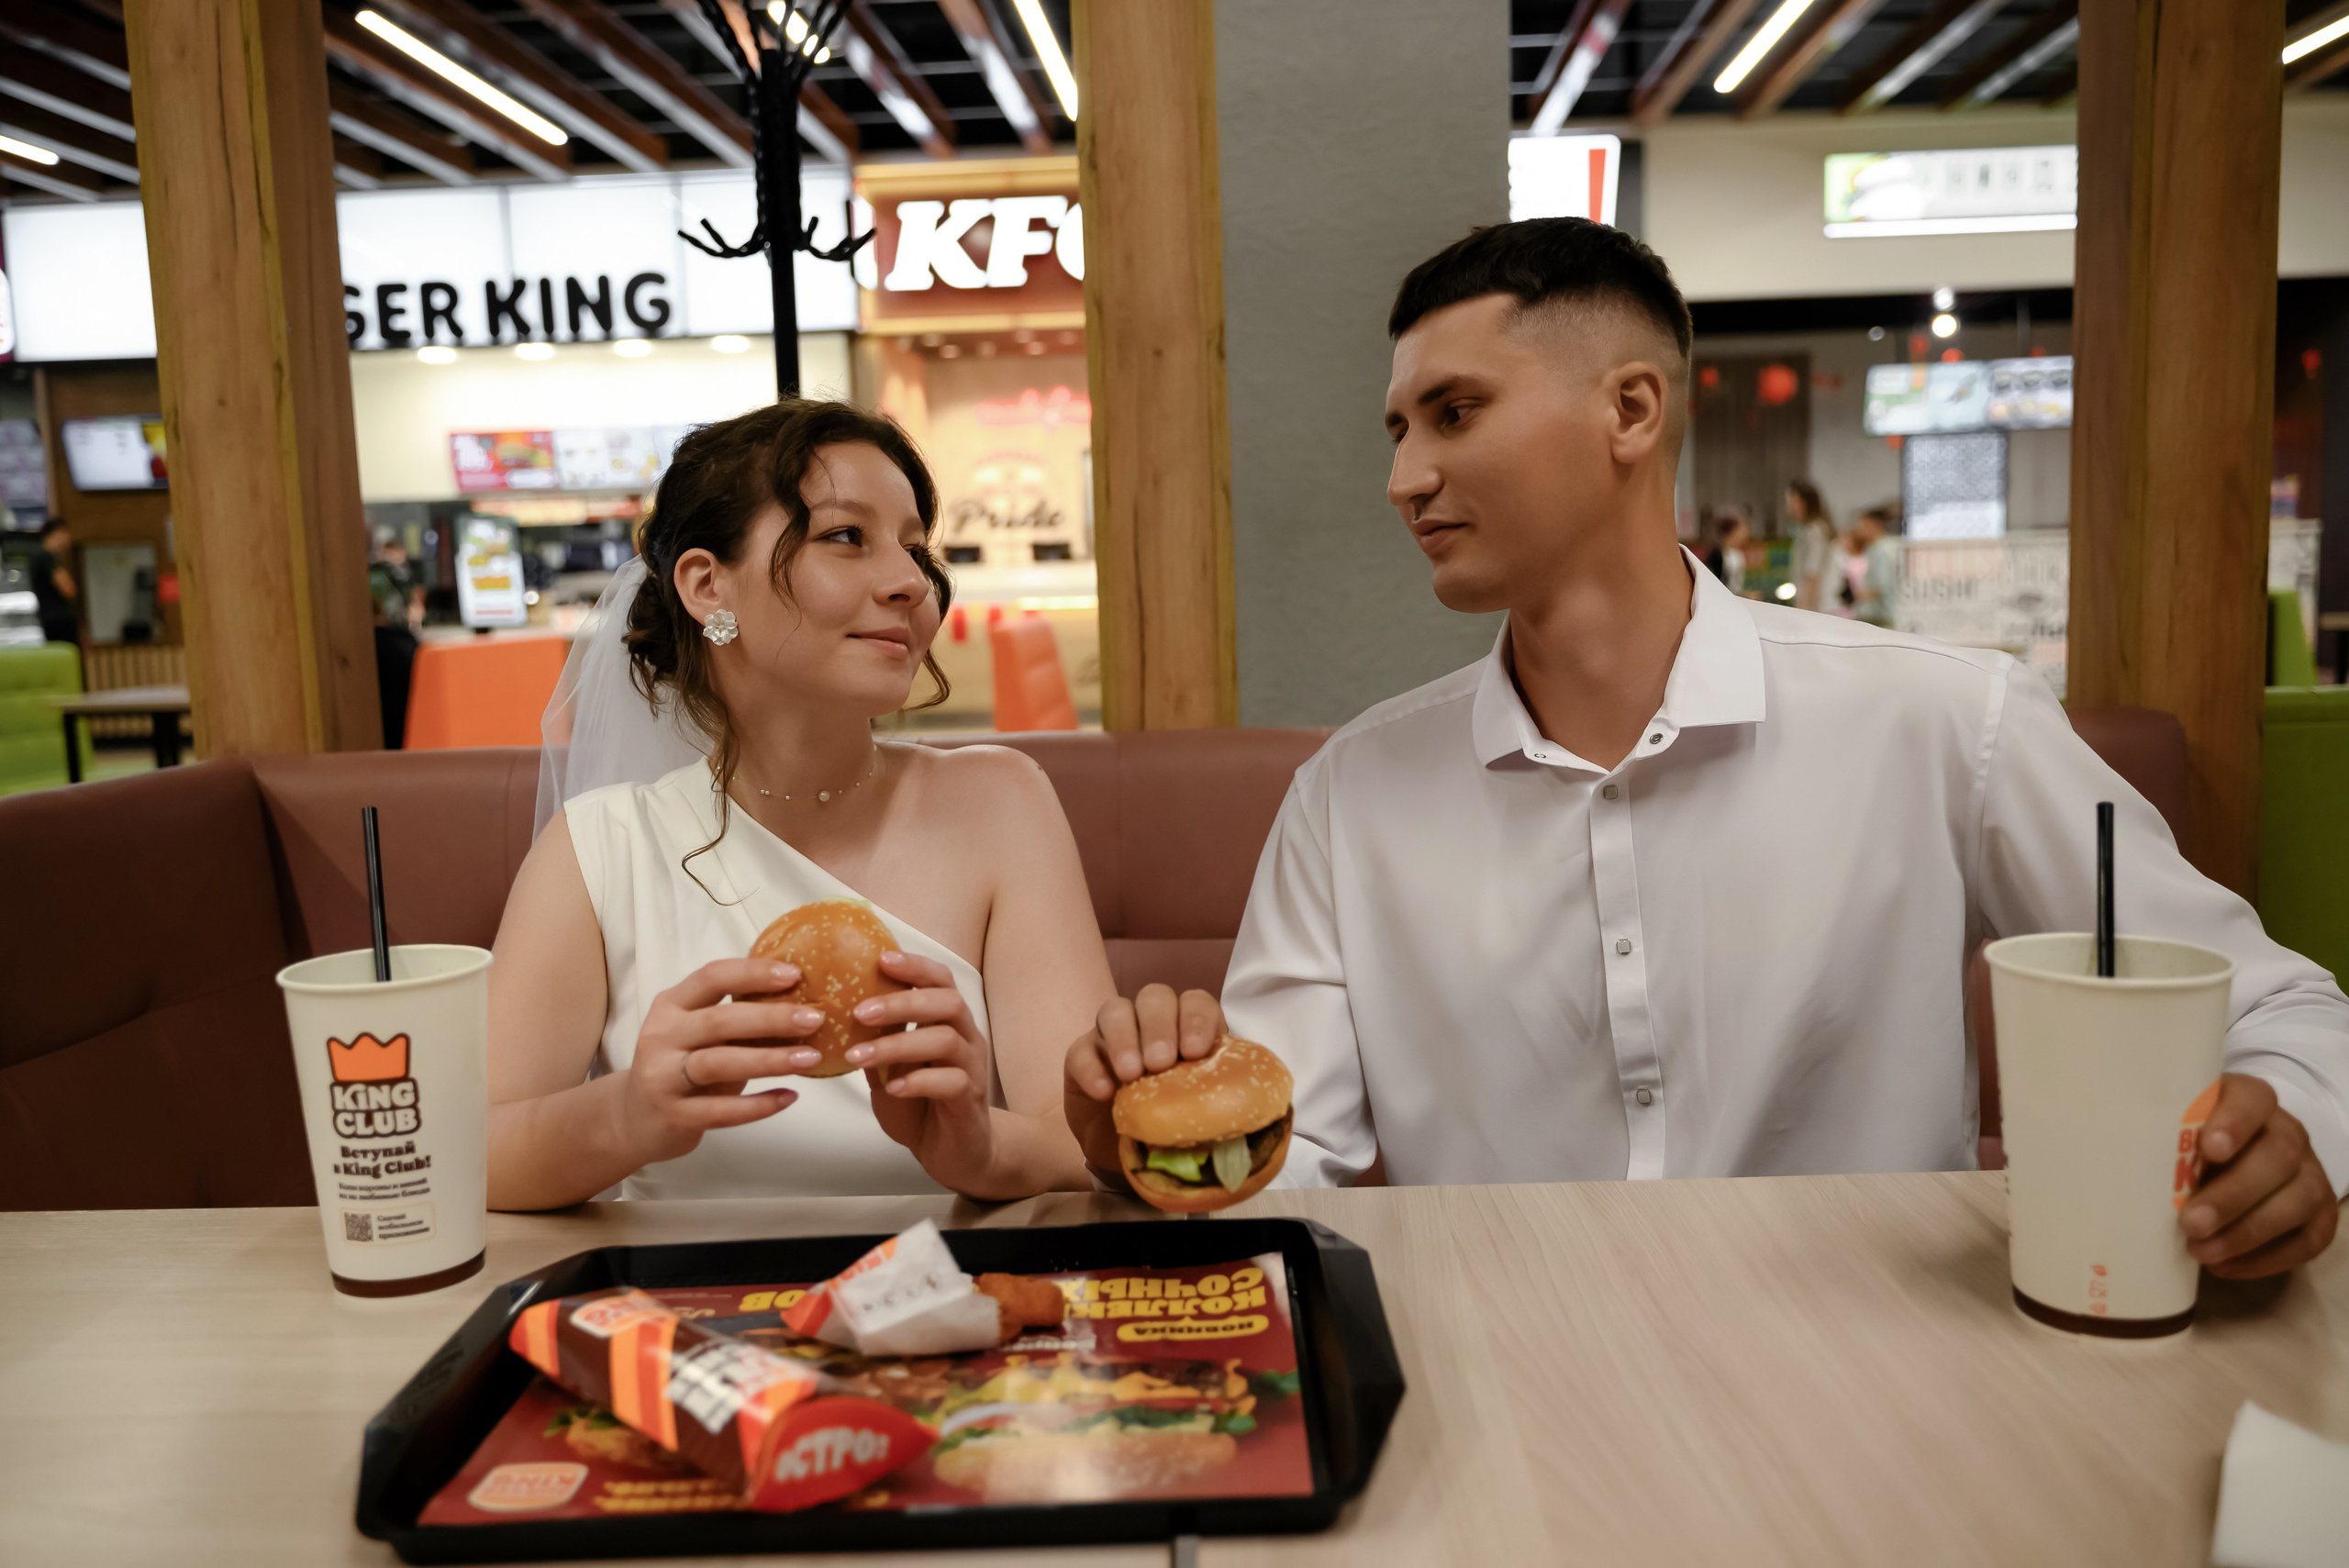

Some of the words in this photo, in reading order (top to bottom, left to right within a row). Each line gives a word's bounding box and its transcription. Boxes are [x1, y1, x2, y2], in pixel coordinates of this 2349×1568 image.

[485, 272, 671, 338] KING
[332, 1080, 416, 1111] KING
[335, 1107, 418, 1137] CLUB
[340, 1140, 416, 1162] Вступай
[342, 1162, 382, 1179] King
[384, 1154, 432, 1174] Club!
[1063, 1286, 1266, 1318] КОЛЛЕК
[1133, 1321, 1254, 1335] НОВИНКА
